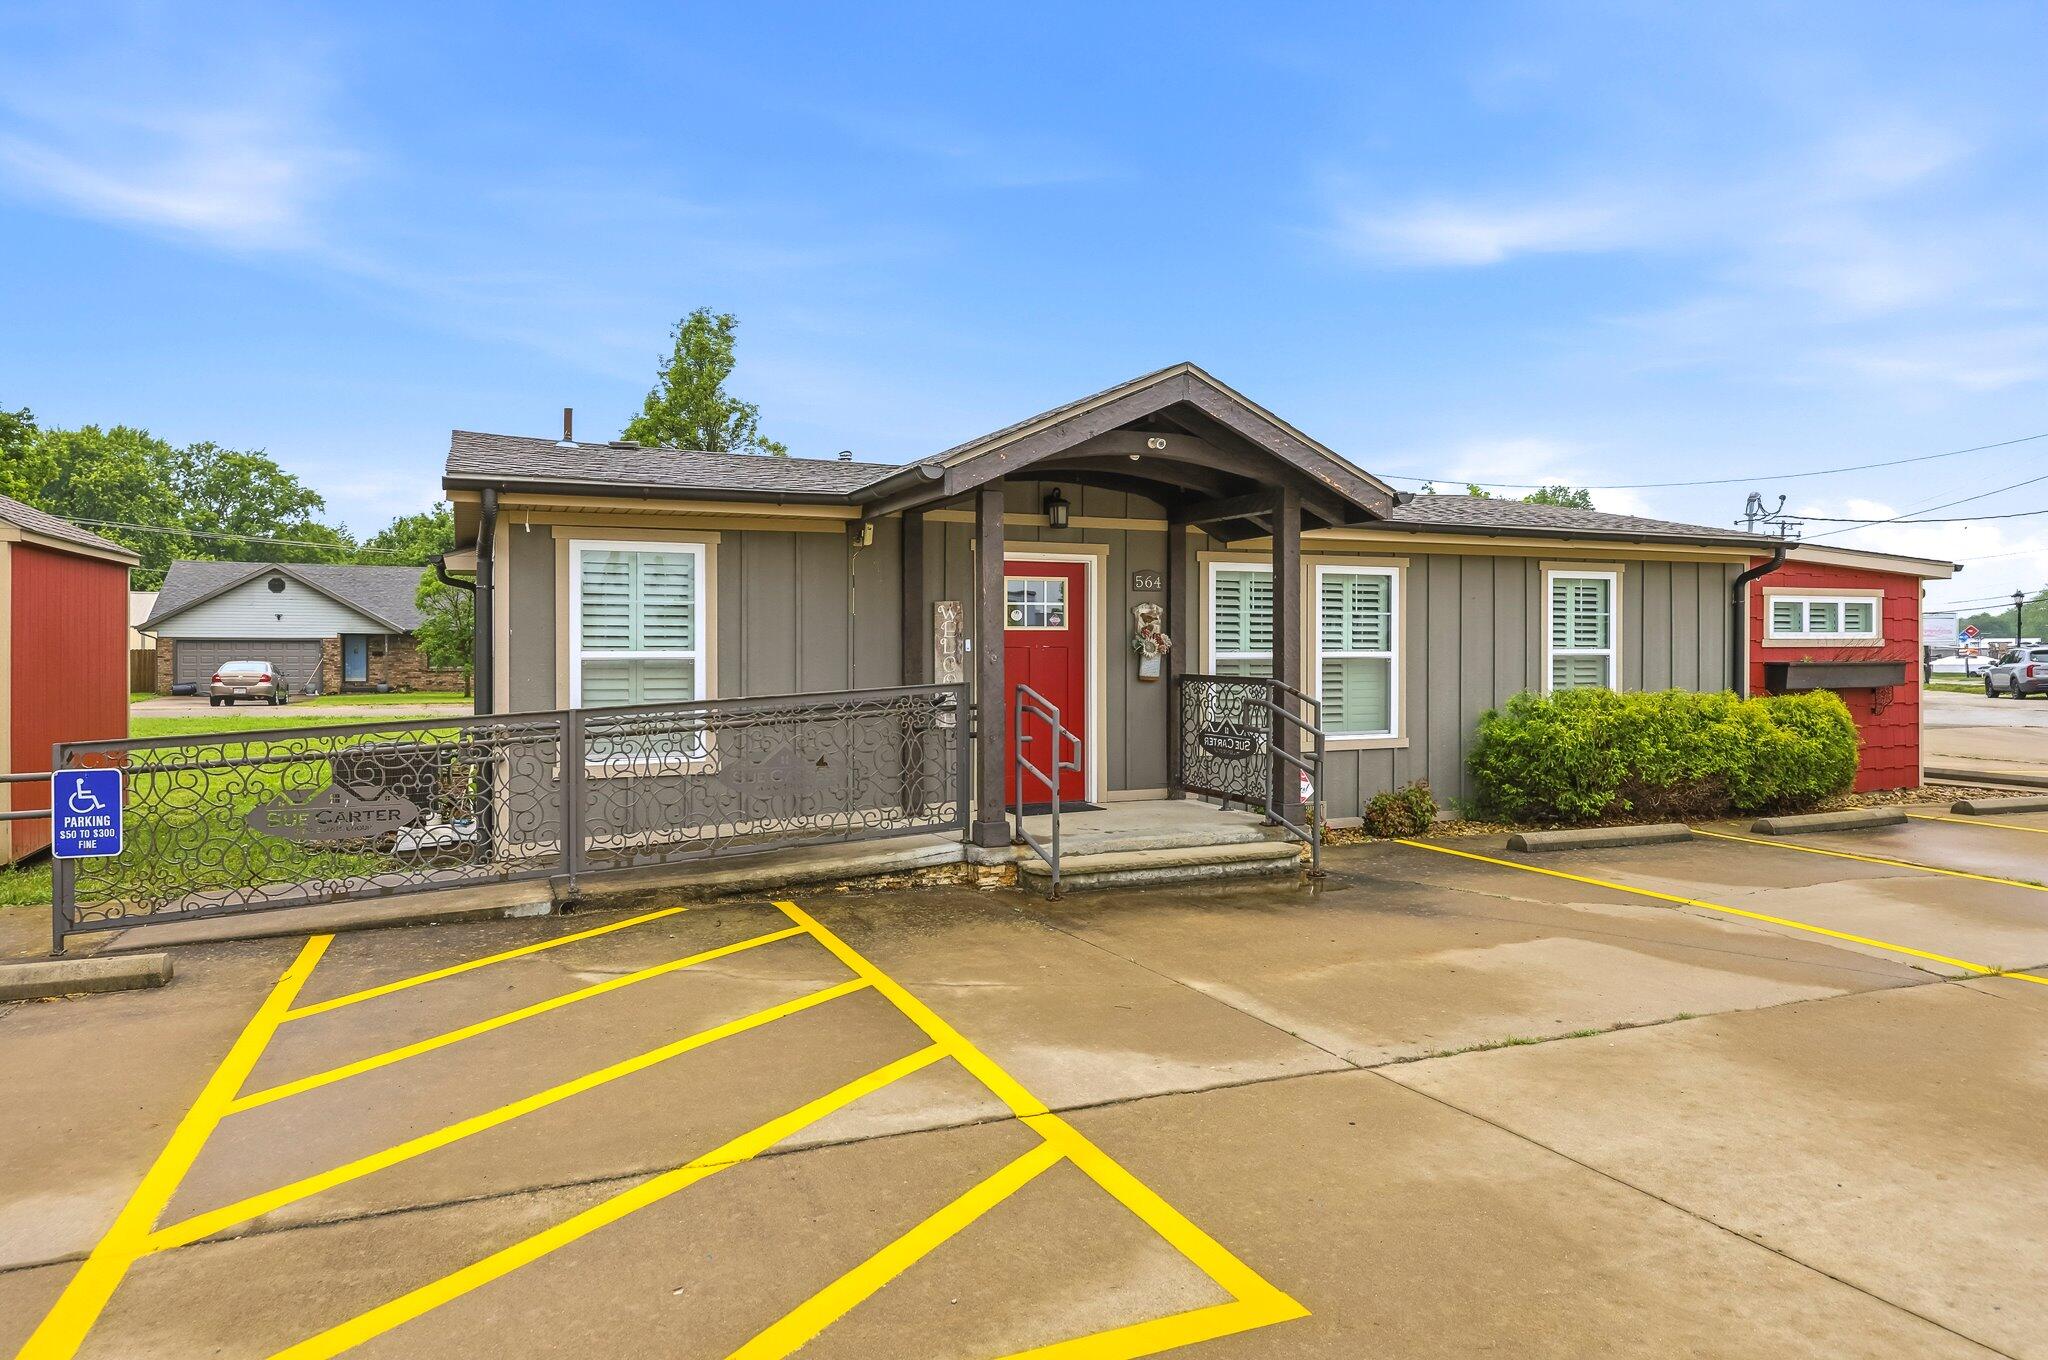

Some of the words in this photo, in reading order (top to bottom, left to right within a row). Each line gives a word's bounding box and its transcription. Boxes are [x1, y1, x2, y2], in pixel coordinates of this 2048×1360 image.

[1135, 575, 1162, 589] 564
[937, 604, 957, 727] WELCO
[64, 815, 111, 828] PARKING
[267, 811, 309, 828] SUE
[315, 809, 401, 825] CARTER
[60, 830, 77, 839] $50
[80, 829, 90, 838] TO
[93, 828, 115, 838] $300
[78, 839, 97, 849] FINE
